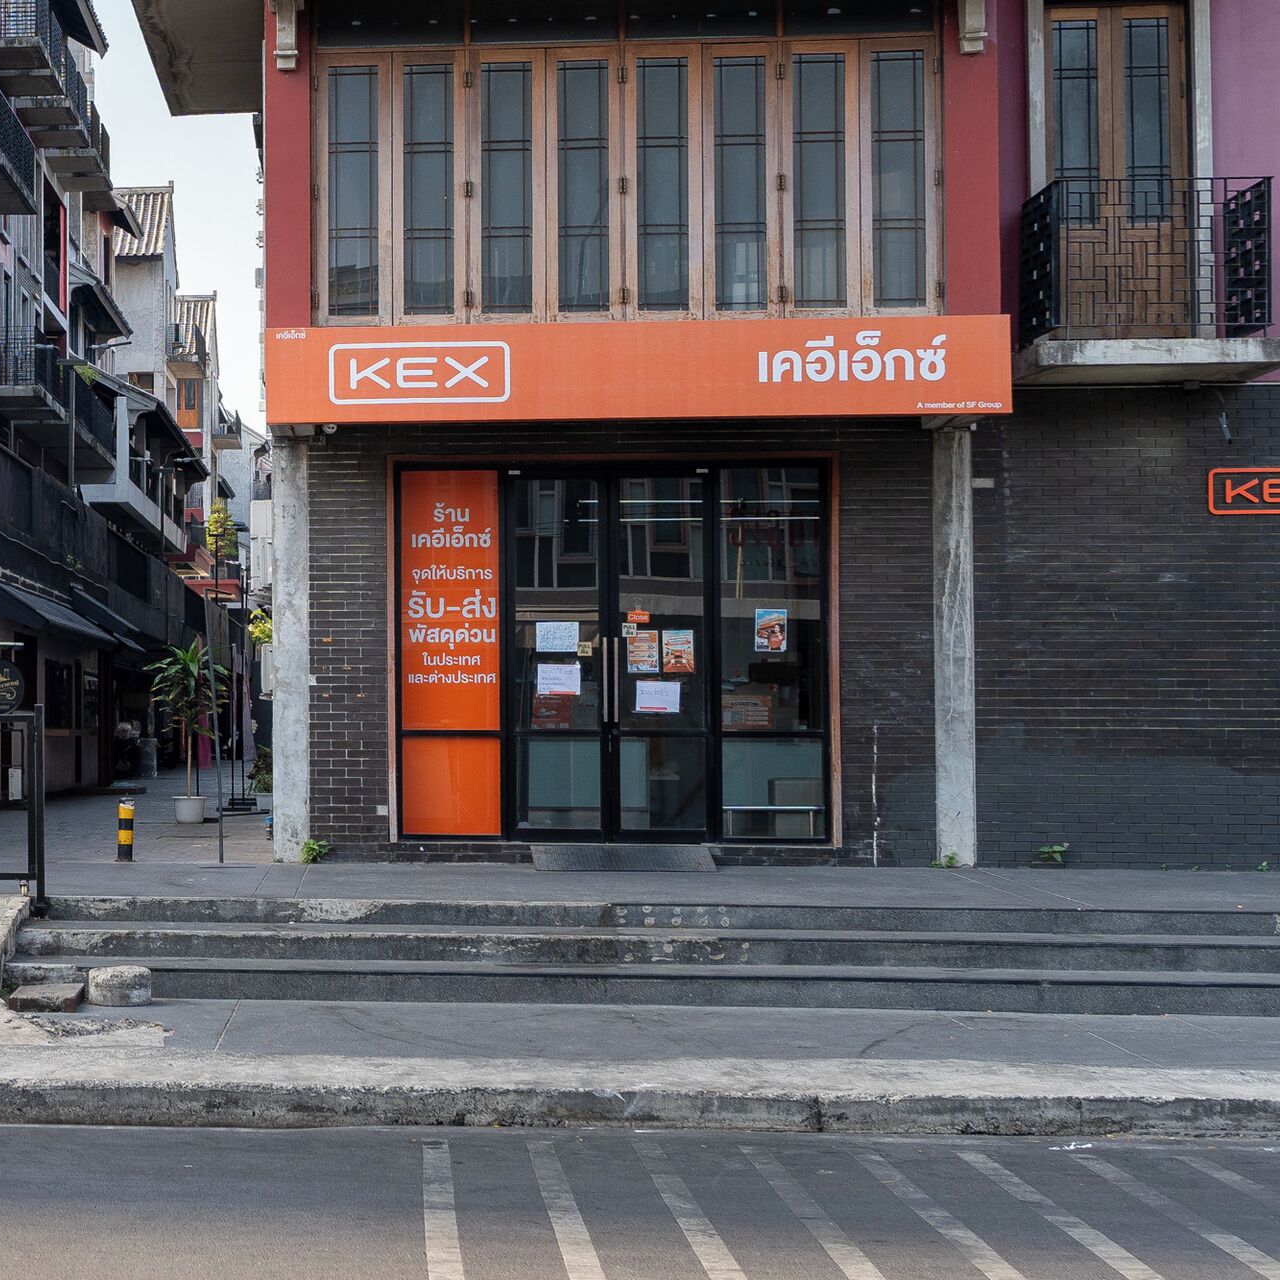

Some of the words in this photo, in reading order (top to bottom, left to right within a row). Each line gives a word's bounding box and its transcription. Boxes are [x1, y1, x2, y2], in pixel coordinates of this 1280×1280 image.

[758, 330, 948, 383] เคอีเอ็กซ์
[349, 355, 490, 391] KEX
[956, 401, 965, 409] of
[977, 401, 1003, 409] Group
[433, 502, 470, 523] ร้าน
[411, 526, 491, 548] เคอีเอ็กซ์
[412, 564, 493, 585] จุดให้บริการ
[407, 588, 496, 618] รับ-ส่ง
[627, 613, 649, 621] Close
[408, 623, 496, 650] พัสดุด่วน
[422, 651, 481, 666] ในประเทศ
[408, 670, 496, 684] และต่างประเทศ
